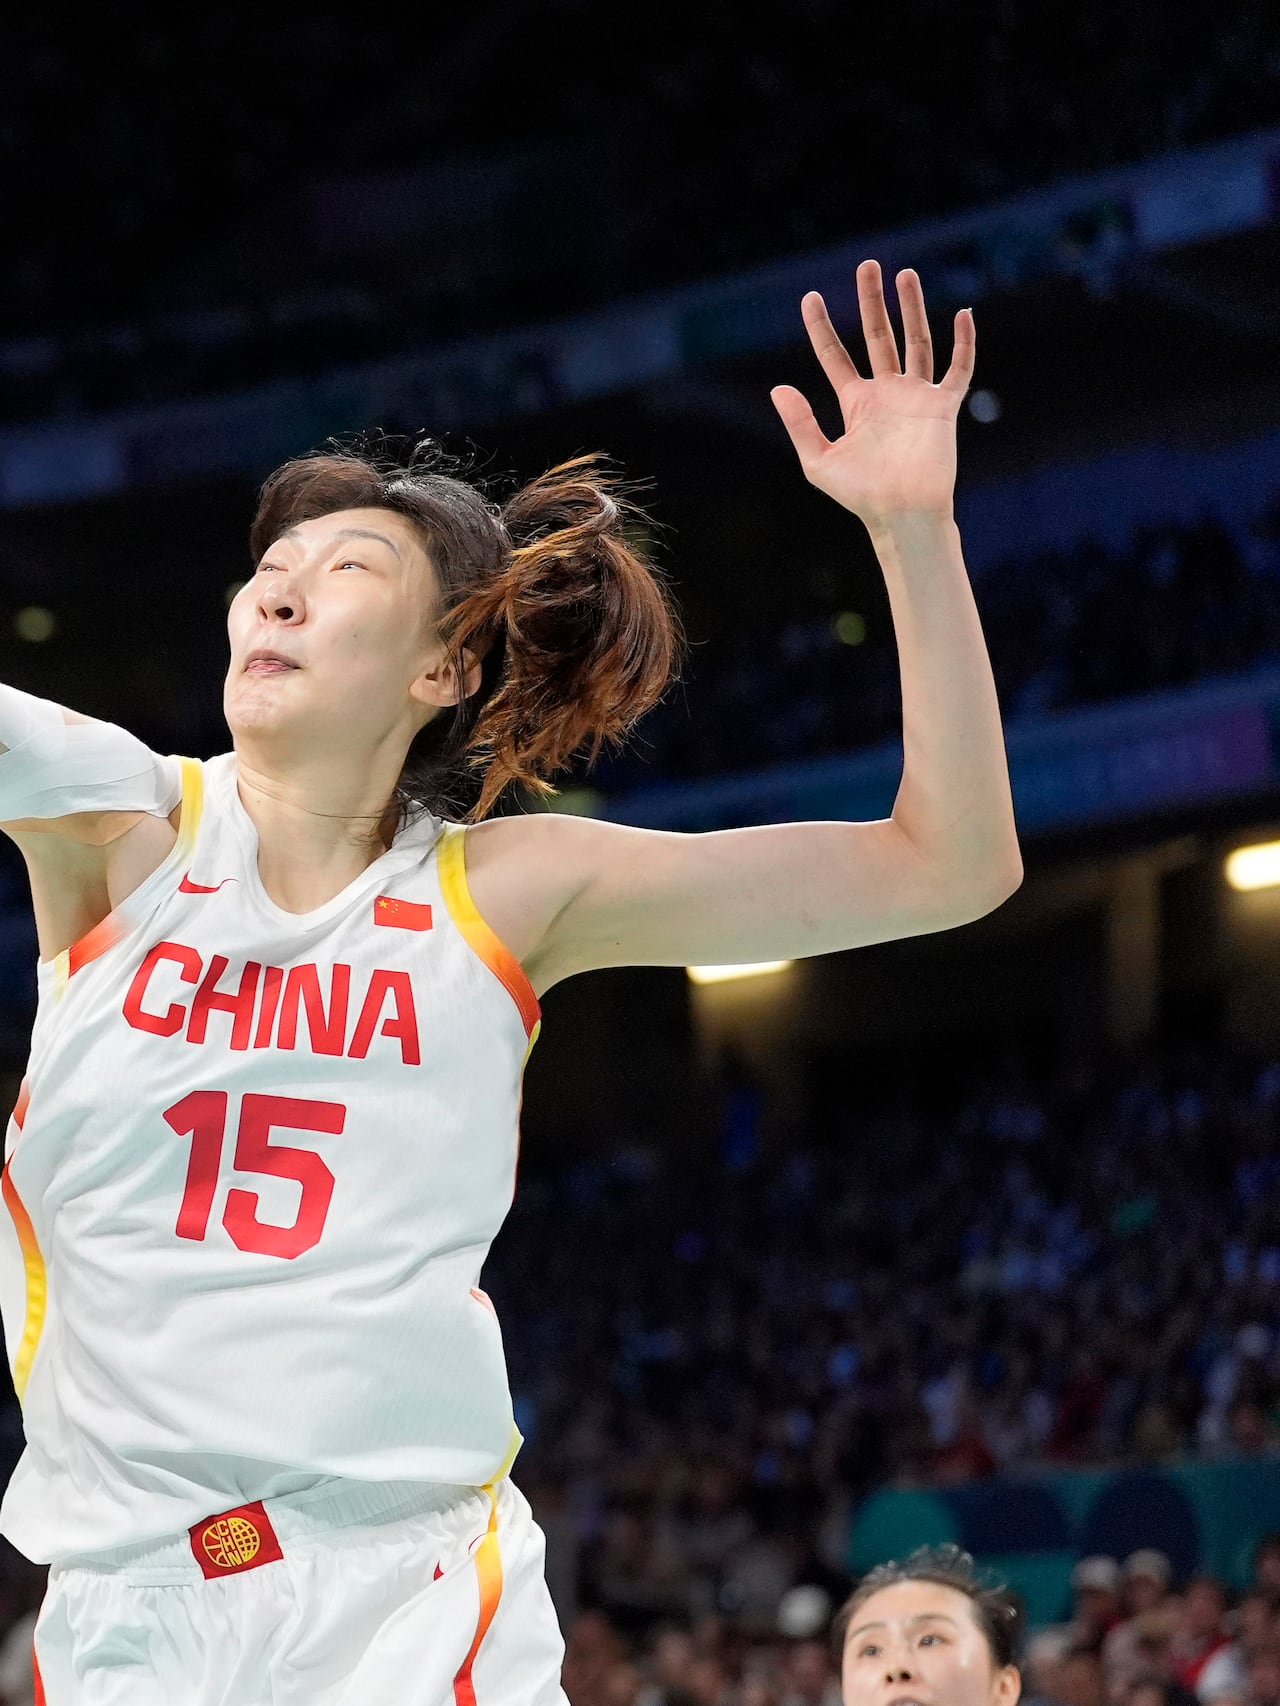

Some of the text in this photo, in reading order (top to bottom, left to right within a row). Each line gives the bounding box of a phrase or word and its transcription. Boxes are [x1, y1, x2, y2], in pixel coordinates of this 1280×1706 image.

[122, 941, 421, 1066] CHINA
[162, 1090, 347, 1260] 15
[218, 1520, 244, 1567] CHN
